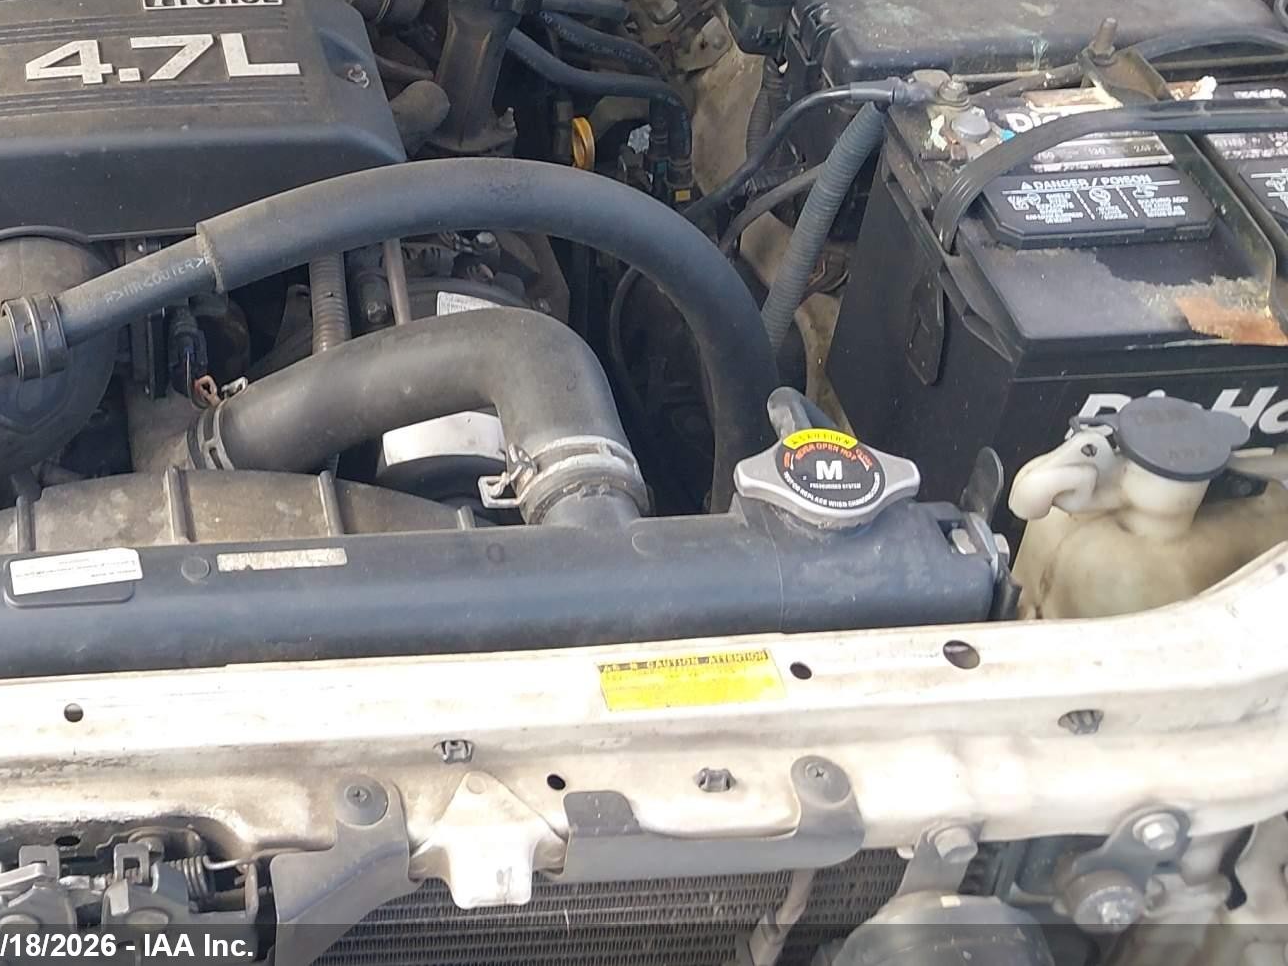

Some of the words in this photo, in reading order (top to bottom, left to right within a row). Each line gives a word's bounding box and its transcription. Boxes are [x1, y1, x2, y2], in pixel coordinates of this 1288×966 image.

[25, 33, 301, 86] 4.7L
[1032, 178, 1089, 191] DANGER
[1100, 174, 1153, 187] POISON
[815, 459, 843, 481] M
